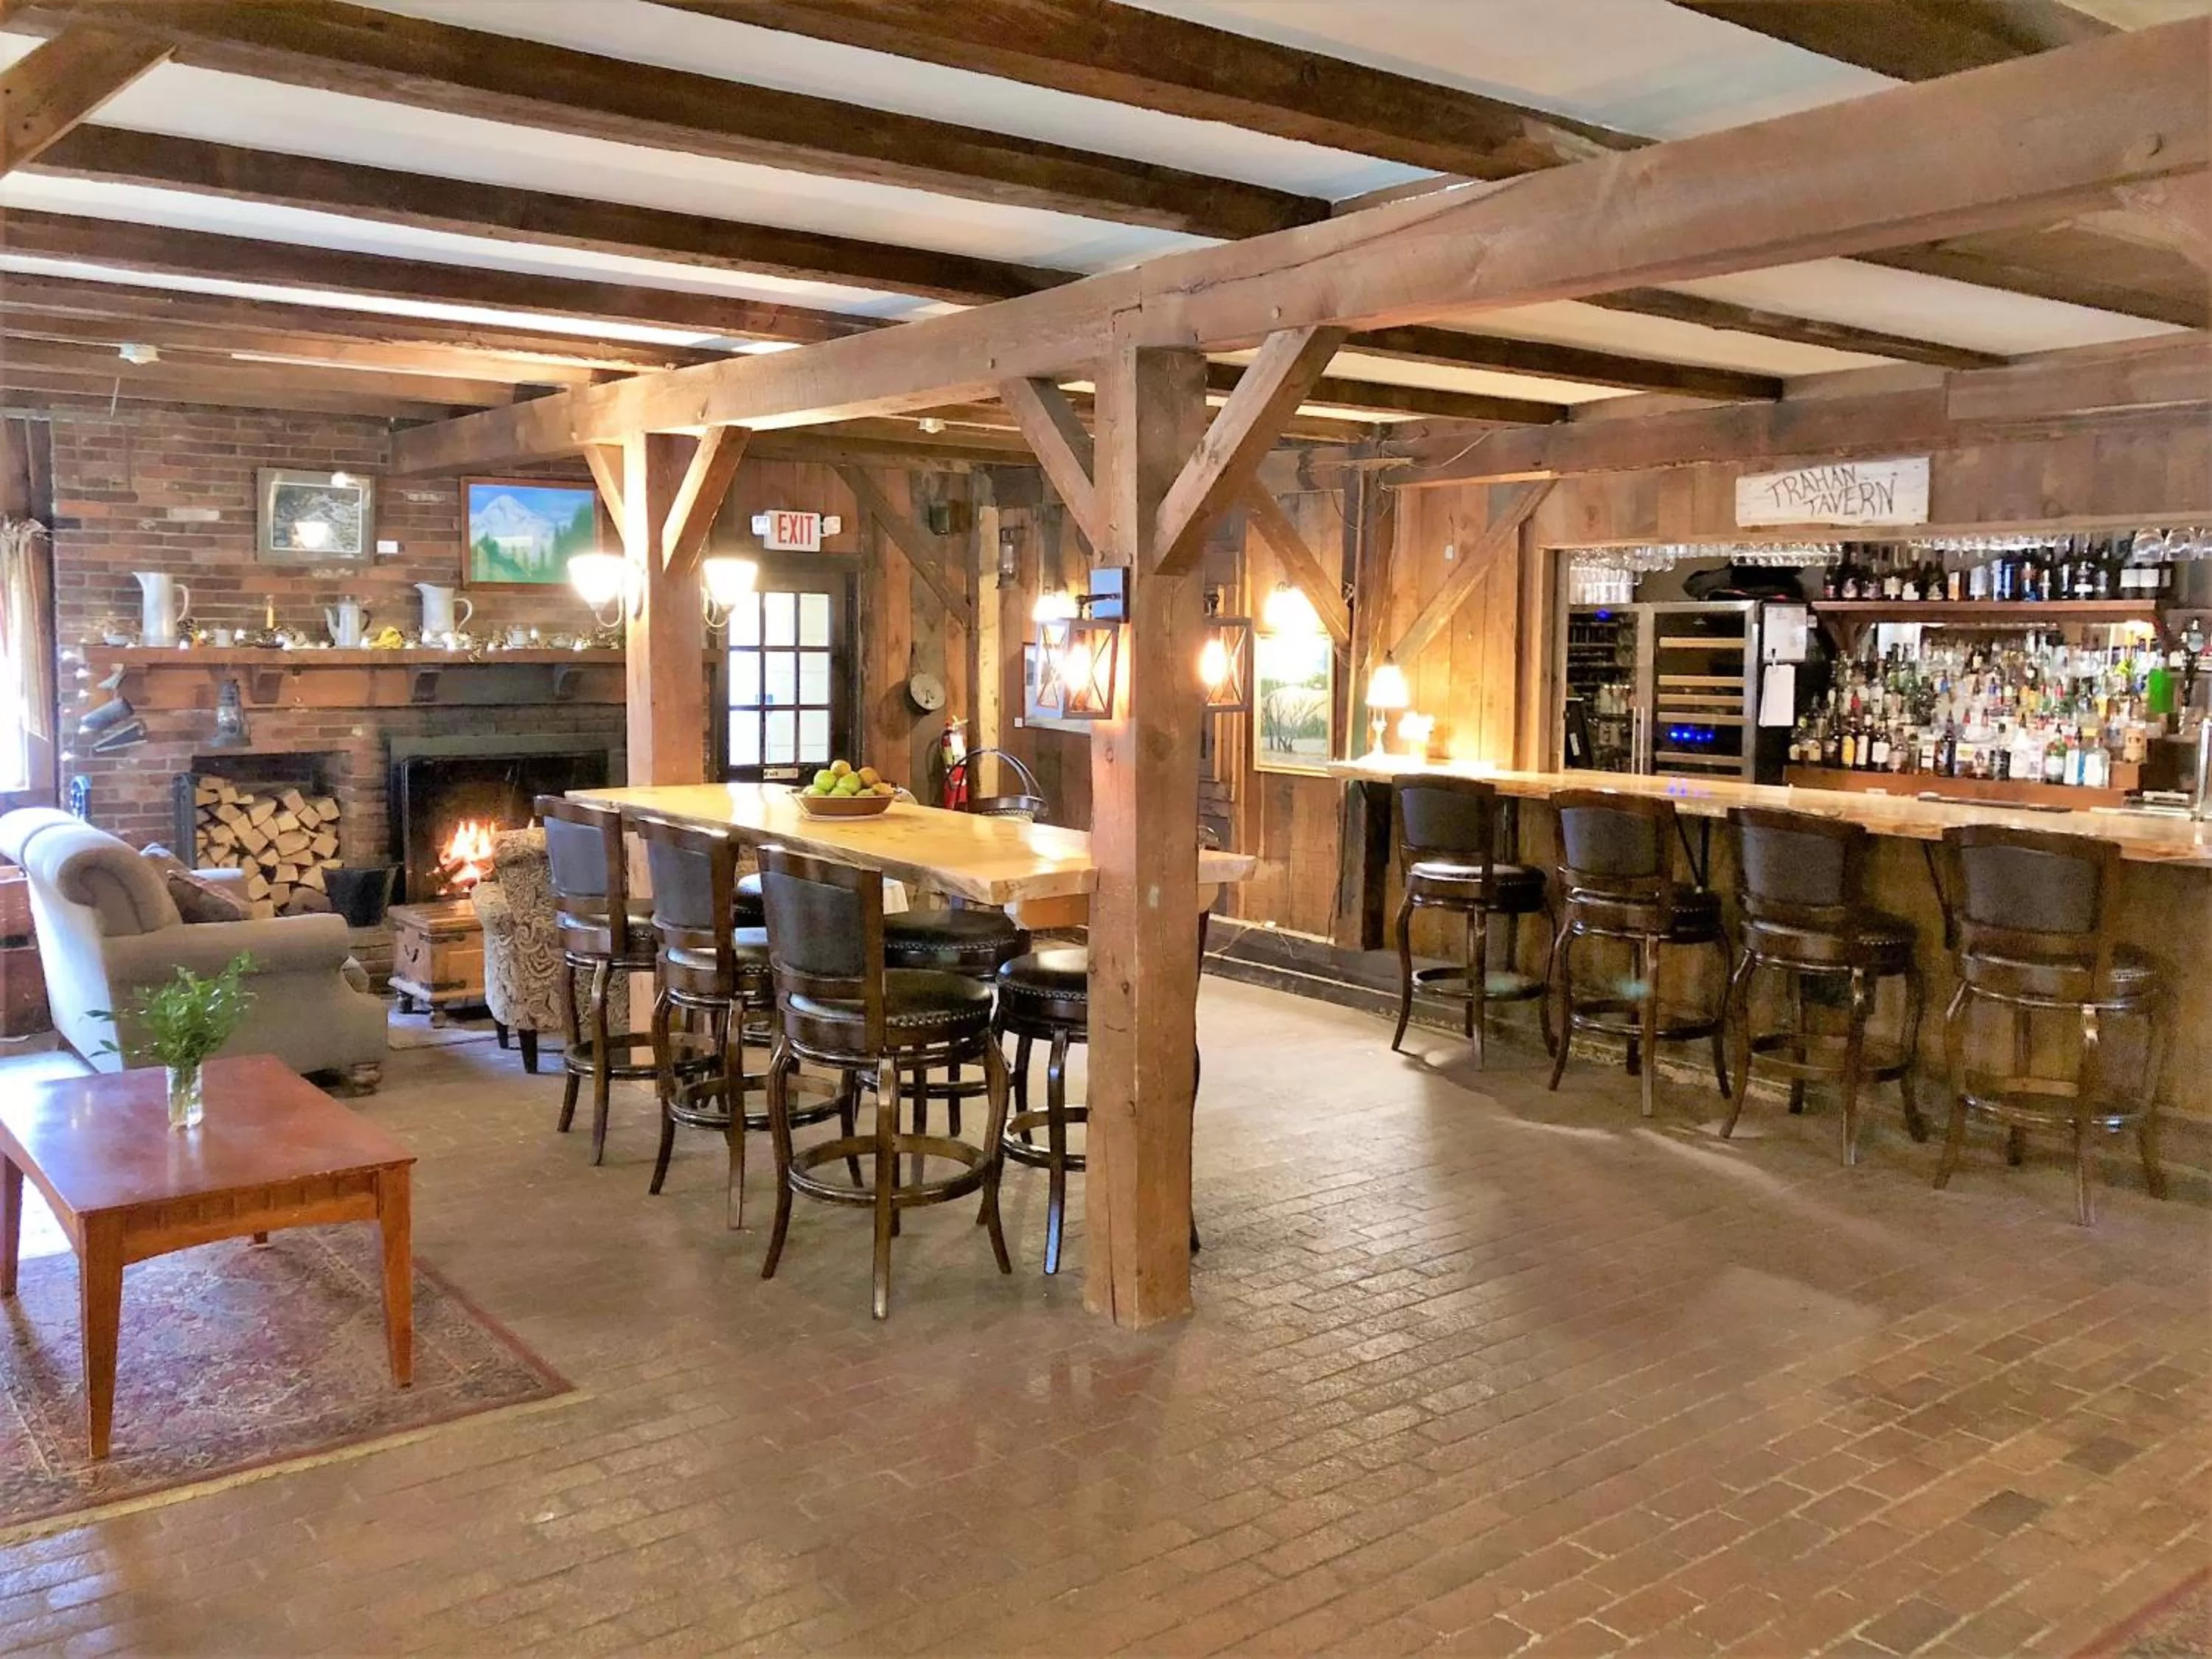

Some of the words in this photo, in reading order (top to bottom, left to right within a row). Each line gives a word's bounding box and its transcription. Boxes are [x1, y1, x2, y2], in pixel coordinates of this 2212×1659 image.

[1764, 465, 1856, 508] TRAHAN
[1804, 478, 1896, 516] TAVERN
[778, 514, 814, 544] EXIT
